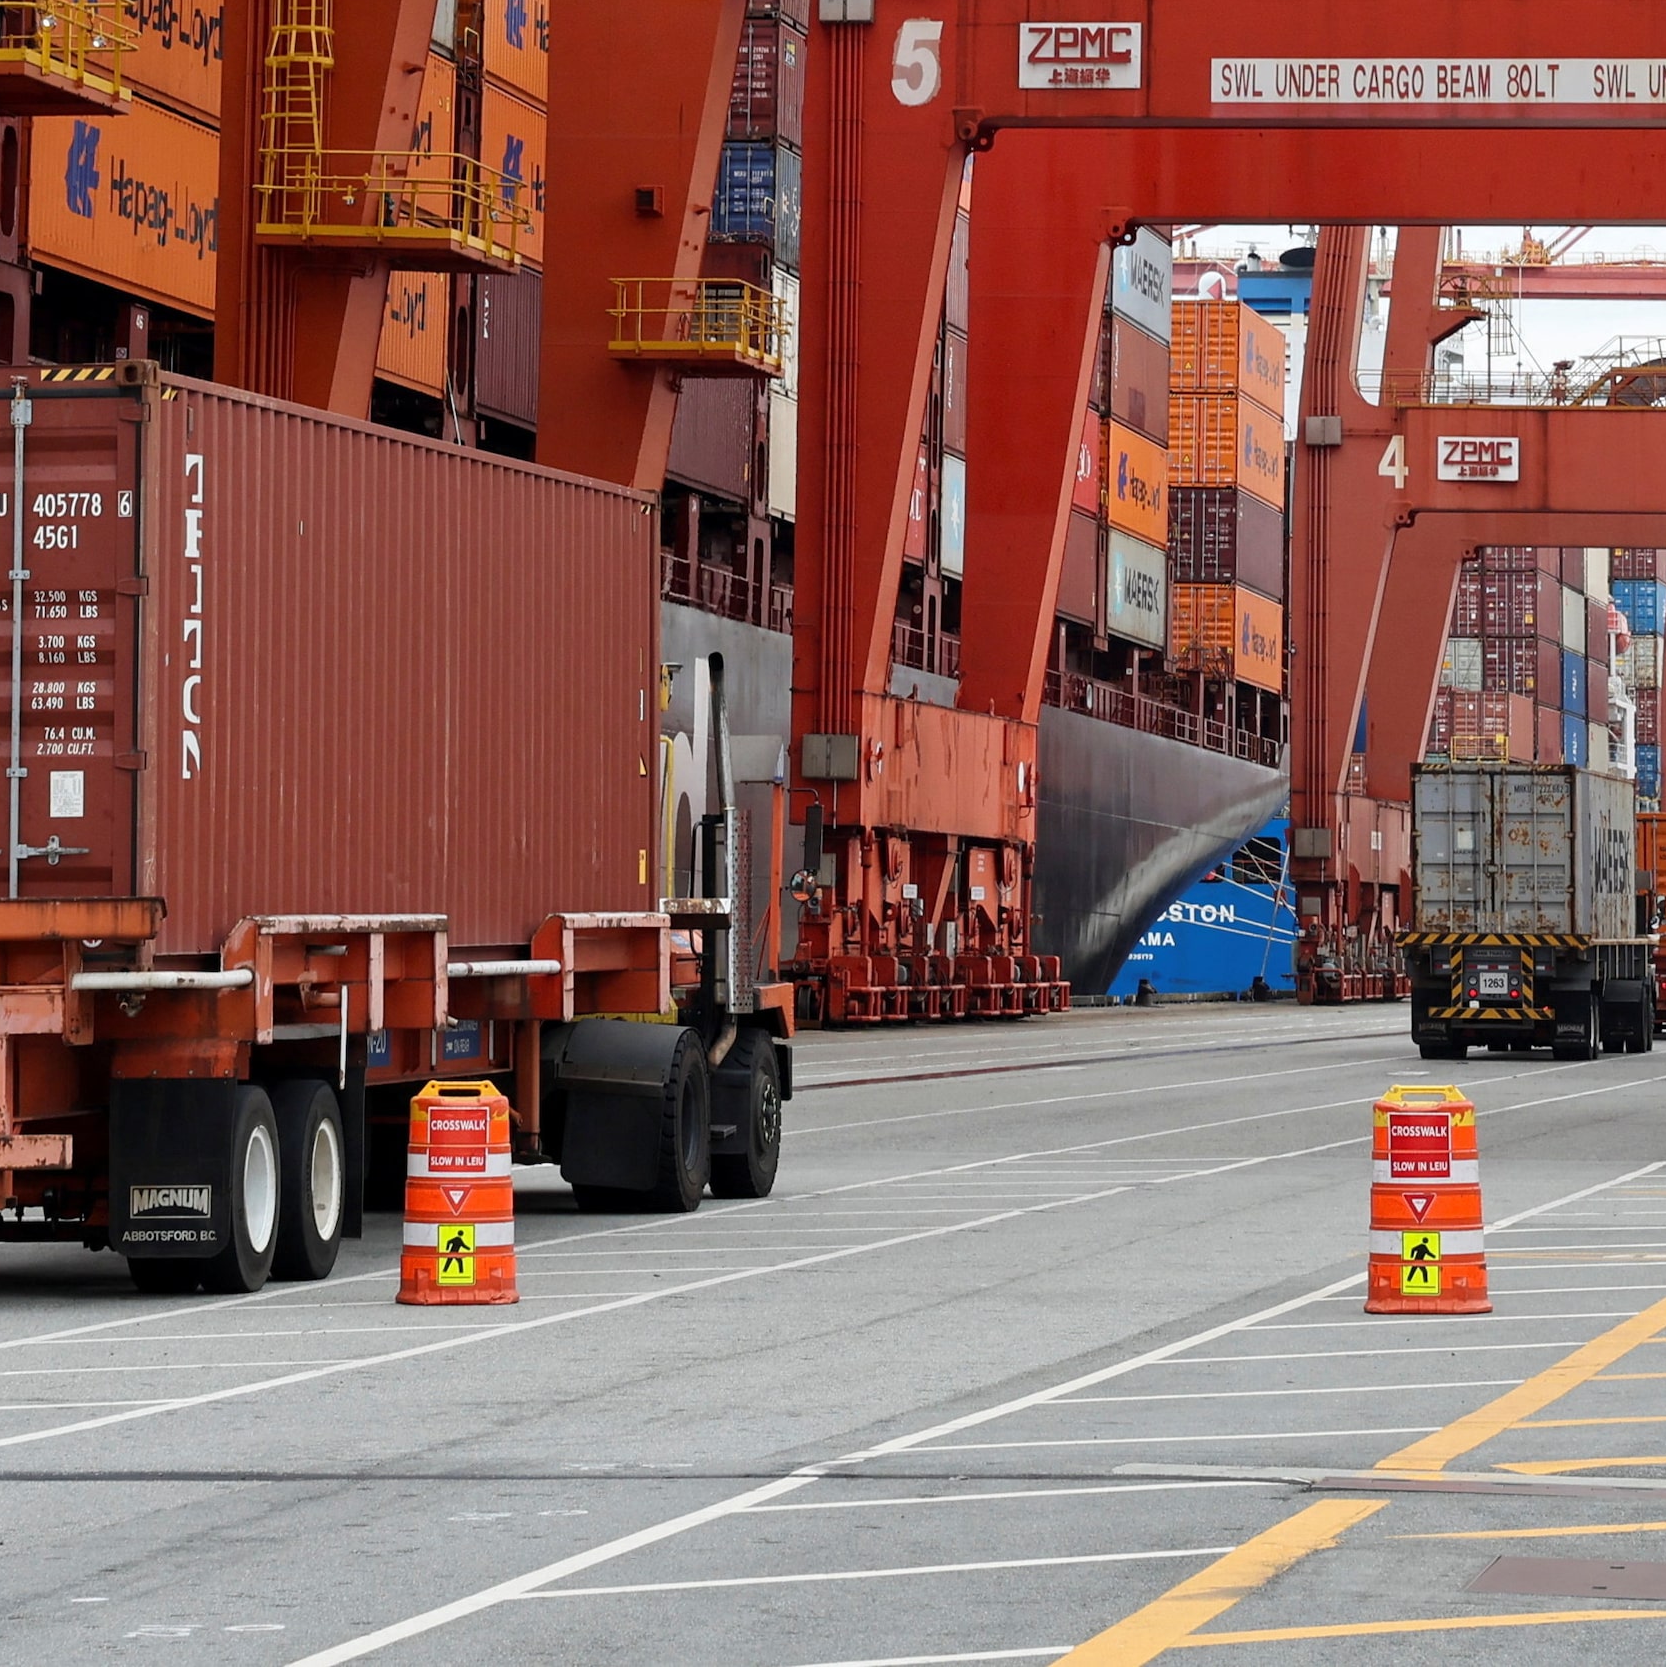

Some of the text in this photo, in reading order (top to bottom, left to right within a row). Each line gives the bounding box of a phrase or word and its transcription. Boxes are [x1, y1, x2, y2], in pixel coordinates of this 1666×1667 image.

[1027, 27, 1132, 64] ZPMC
[891, 21, 944, 106] 5
[1221, 64, 1263, 98] SWL
[1275, 64, 1339, 98] UNDER
[1352, 64, 1424, 99] CARGO
[1436, 64, 1491, 99] BEAM
[1506, 64, 1560, 99] 80LT
[1593, 64, 1636, 98] SWL
[1443, 440, 1513, 465] ZPMC
[1378, 435, 1409, 489] 4
[33, 493, 102, 517] 405778
[119, 492, 132, 516] 6
[33, 525, 78, 550] 45G1
[34, 590, 98, 603] 32.500 KGS
[35, 606, 98, 618] 71.650 LBS
[38, 635, 96, 649] 3.700 KGS
[38, 651, 96, 664] 8.160 LBS
[32, 682, 96, 694] 28.800 KGS
[31, 697, 95, 710] 63.490 LBS
[1483, 978, 1505, 988] 1263
[431, 1120, 485, 1131] CROSSWALK
[1392, 1126, 1447, 1137] CROSSWALK
[431, 1156, 484, 1166] SLOW IN LEIU
[1393, 1162, 1448, 1172] SLOW IN LEIU
[134, 1188, 209, 1216] MAGNUM
